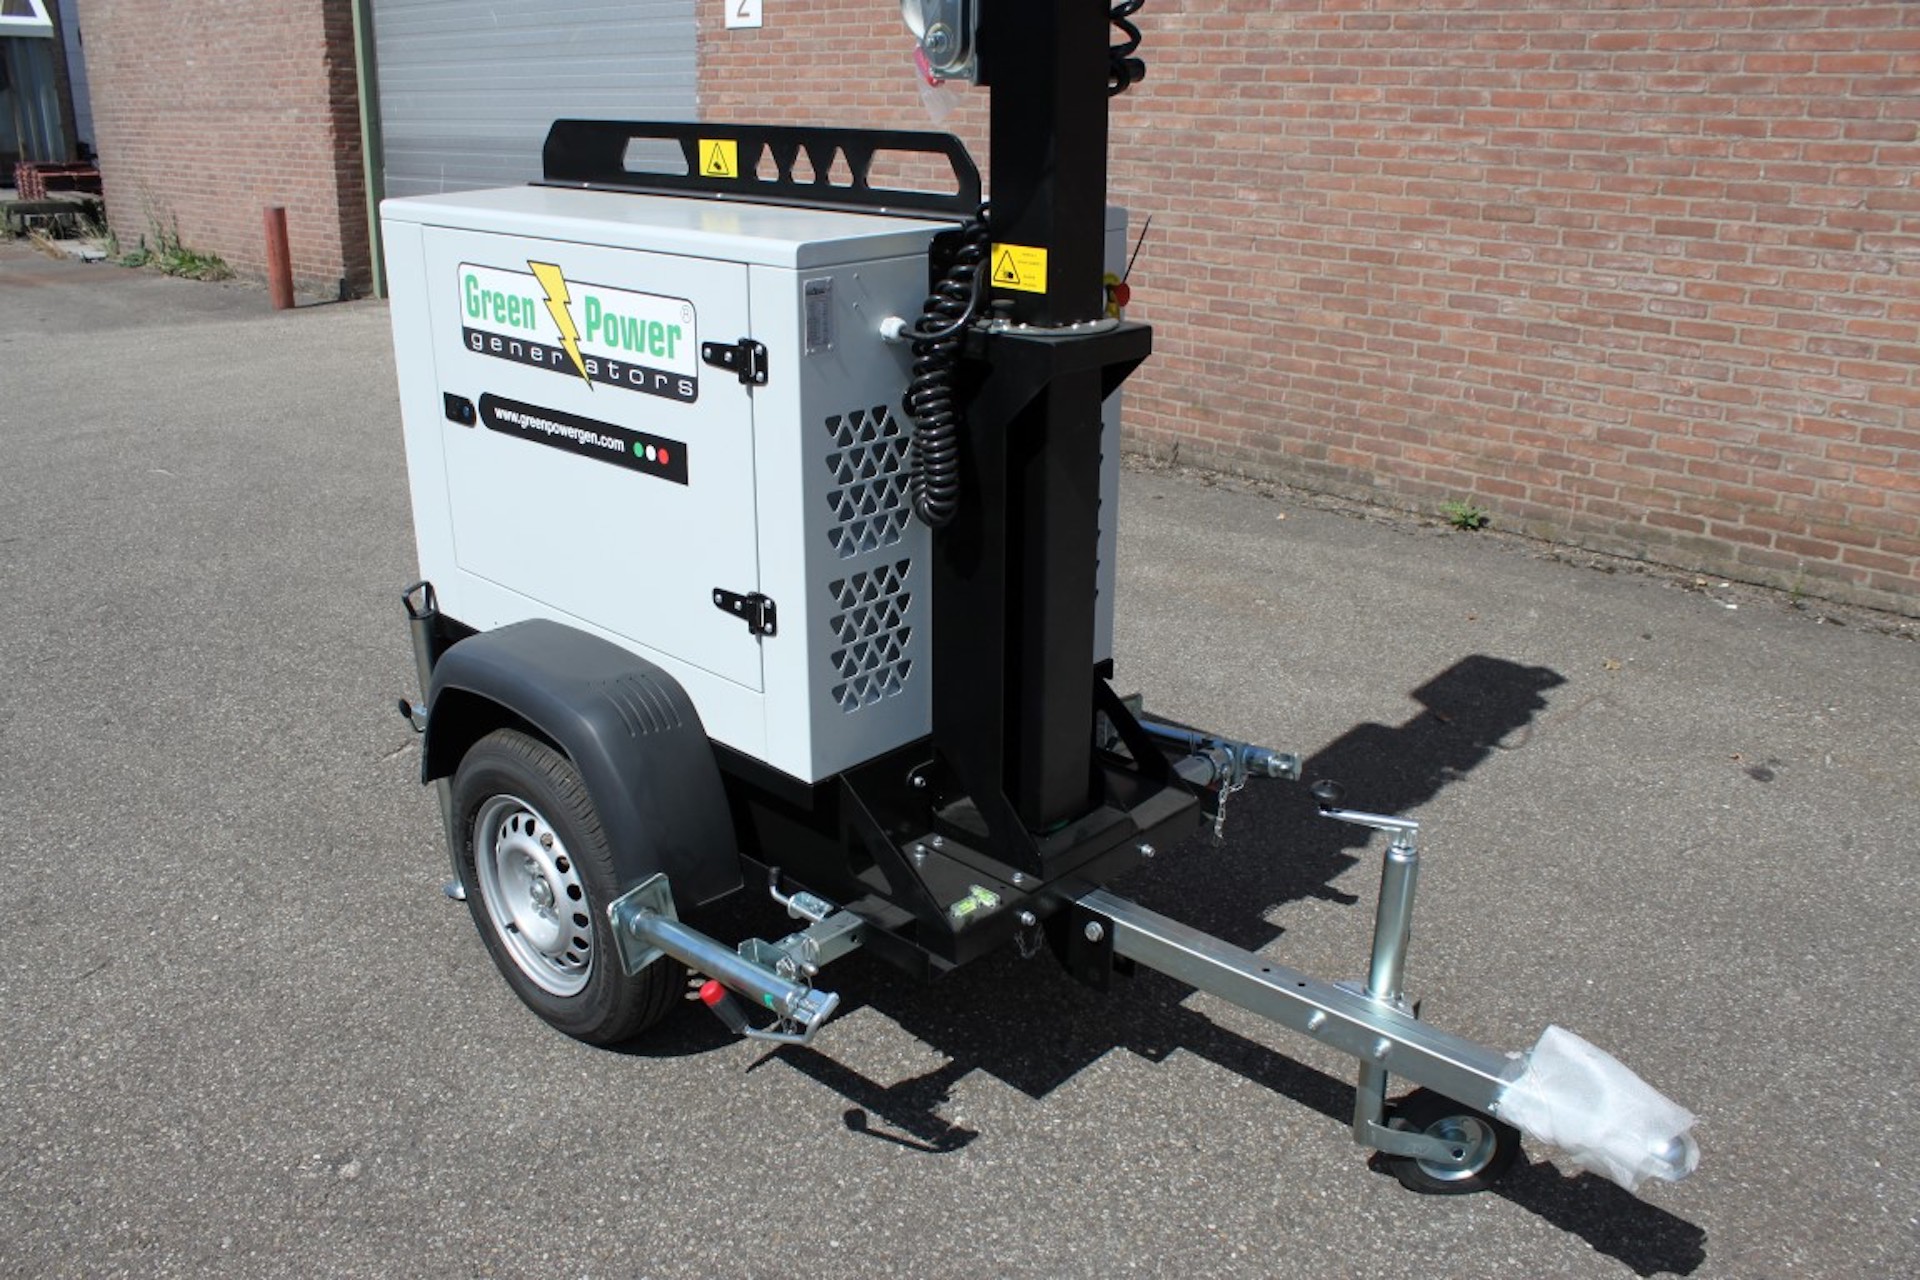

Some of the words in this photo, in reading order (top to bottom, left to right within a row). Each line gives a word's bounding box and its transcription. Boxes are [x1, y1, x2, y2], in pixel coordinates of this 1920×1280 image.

[465, 274, 536, 330] Green
[584, 295, 682, 359] Power
[470, 332, 694, 396] generators
[494, 407, 625, 452] www.greenpowergen.com
